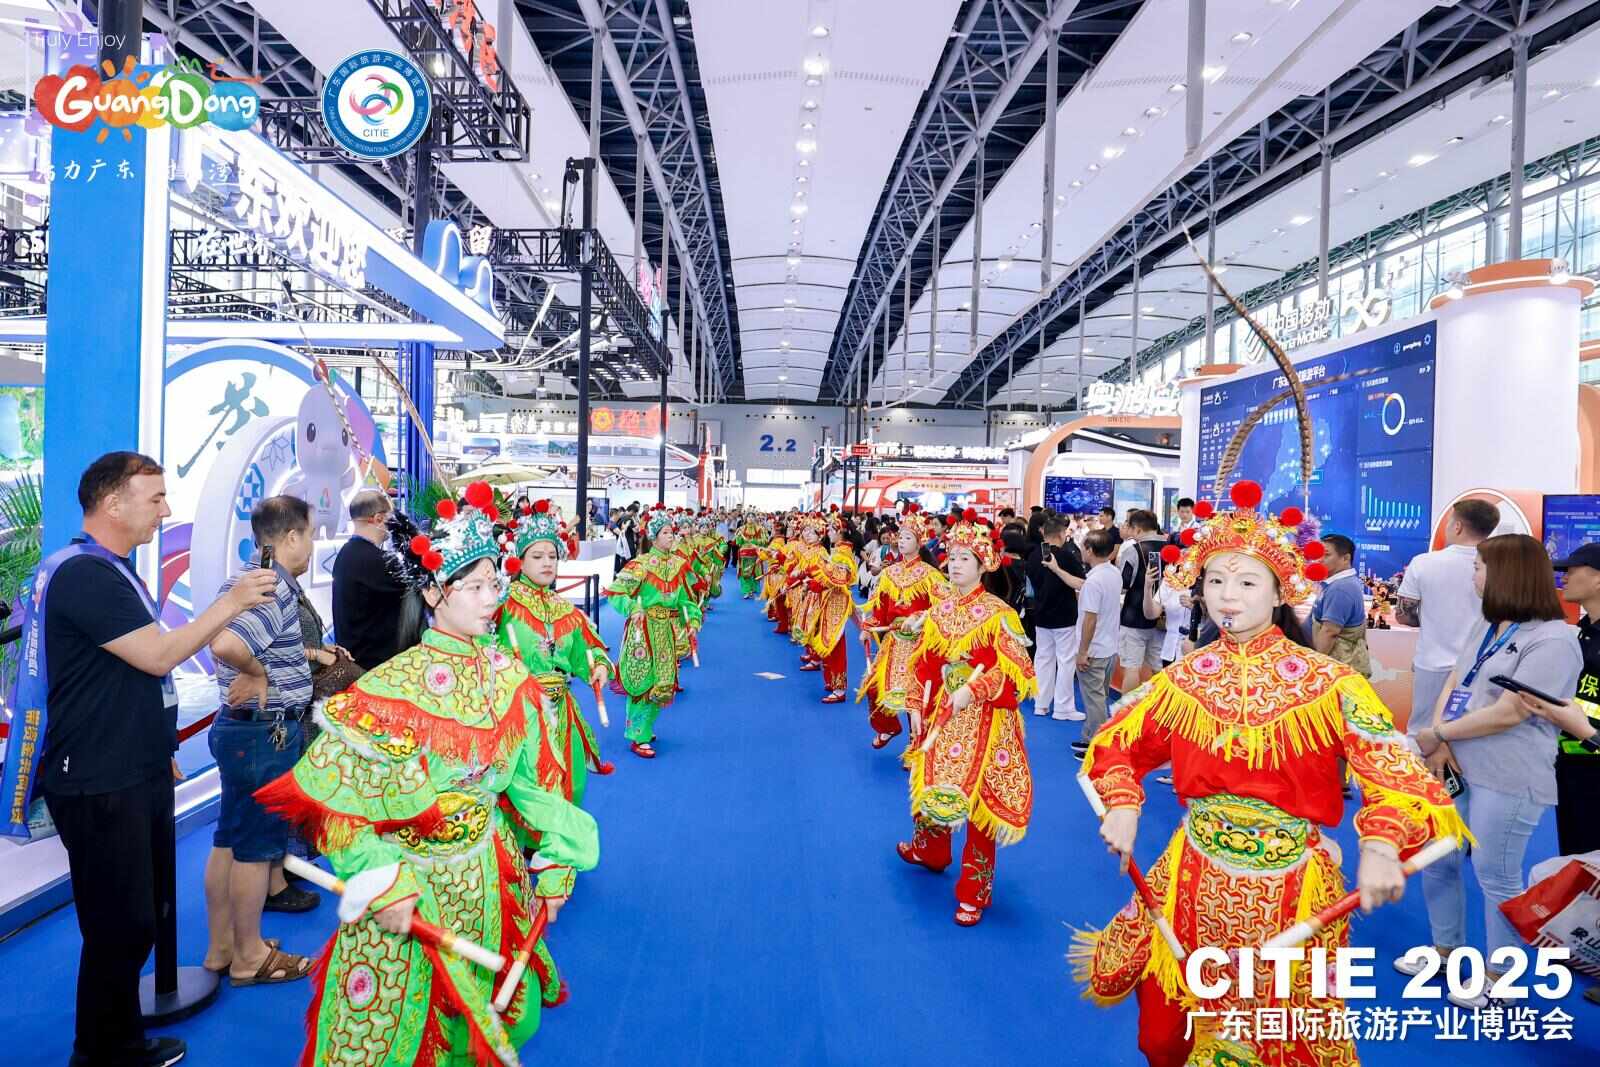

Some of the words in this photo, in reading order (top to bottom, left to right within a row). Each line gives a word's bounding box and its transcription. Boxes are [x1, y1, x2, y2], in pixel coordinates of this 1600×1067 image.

[1272, 297, 1330, 339] 中国移动
[1297, 325, 1330, 347] Mobile
[760, 434, 796, 452] 2.2
[1579, 674, 1600, 697] 保
